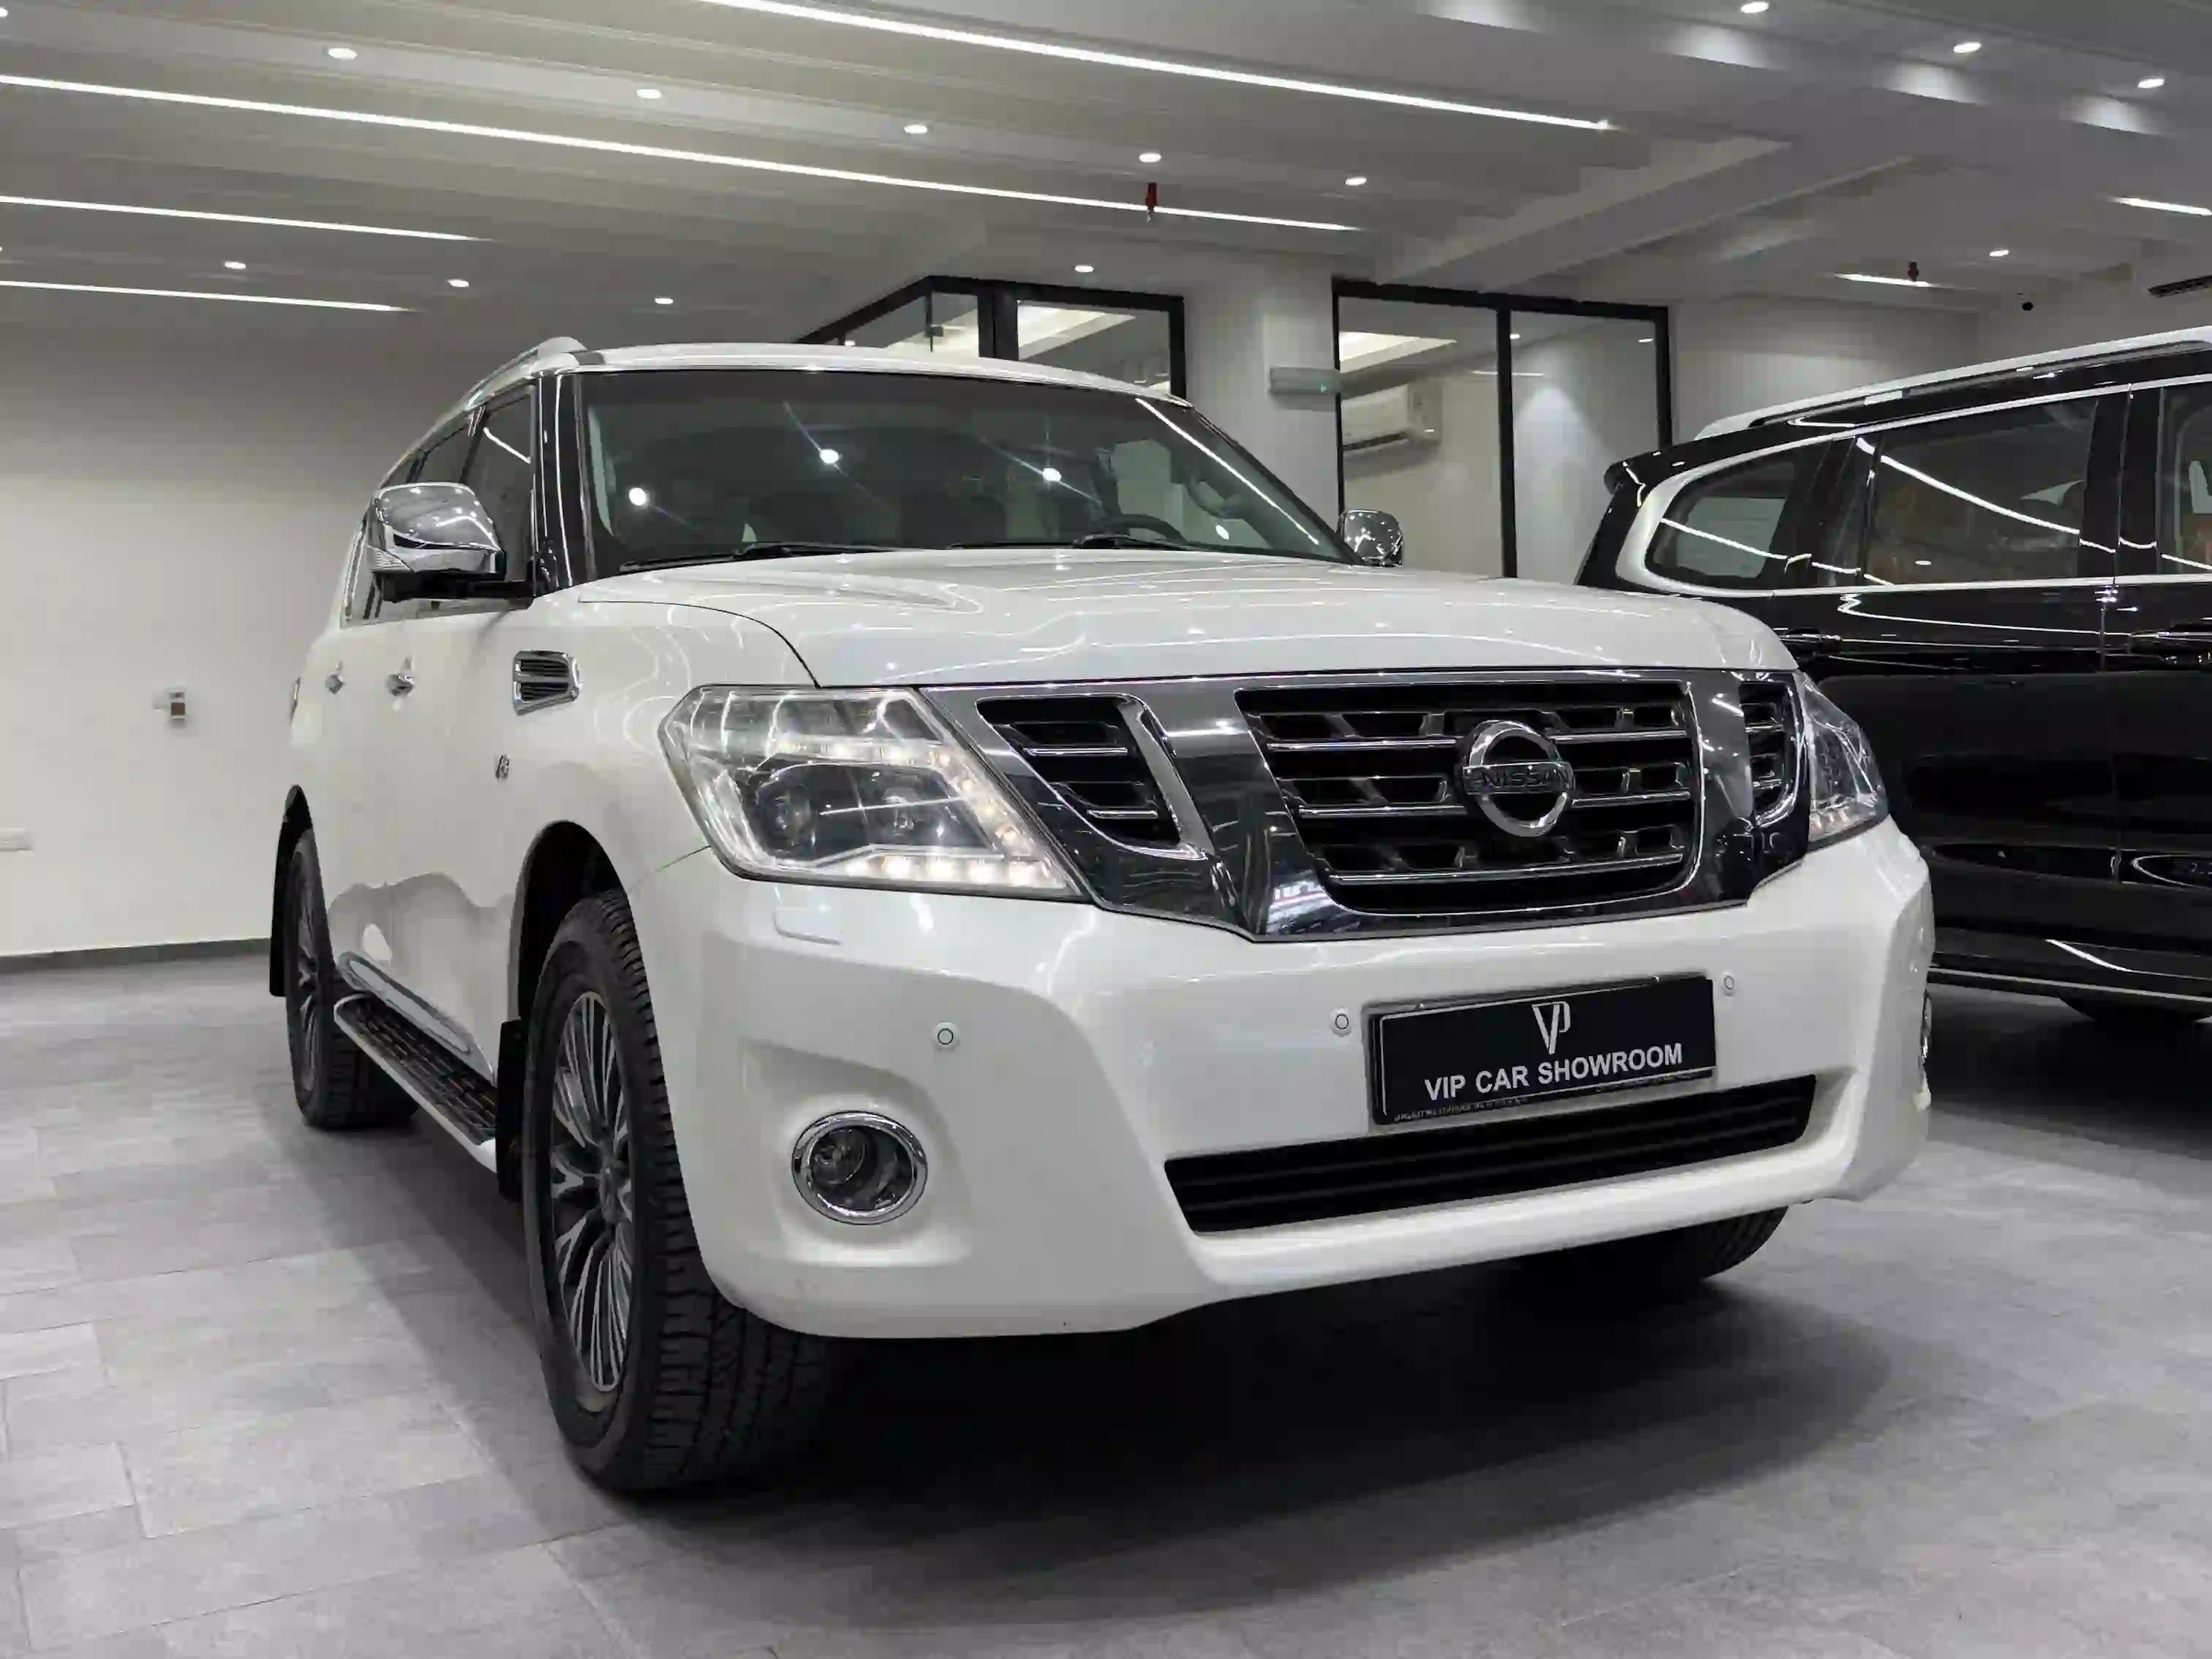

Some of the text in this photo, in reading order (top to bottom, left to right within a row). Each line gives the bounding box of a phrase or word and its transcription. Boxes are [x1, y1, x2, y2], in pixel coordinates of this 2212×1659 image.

[1481, 764, 1568, 789] NISSAN
[1424, 1075, 1467, 1101] VIP
[1475, 1065, 1530, 1094] CAR
[1538, 1042, 1683, 1084] SHOWROOM
